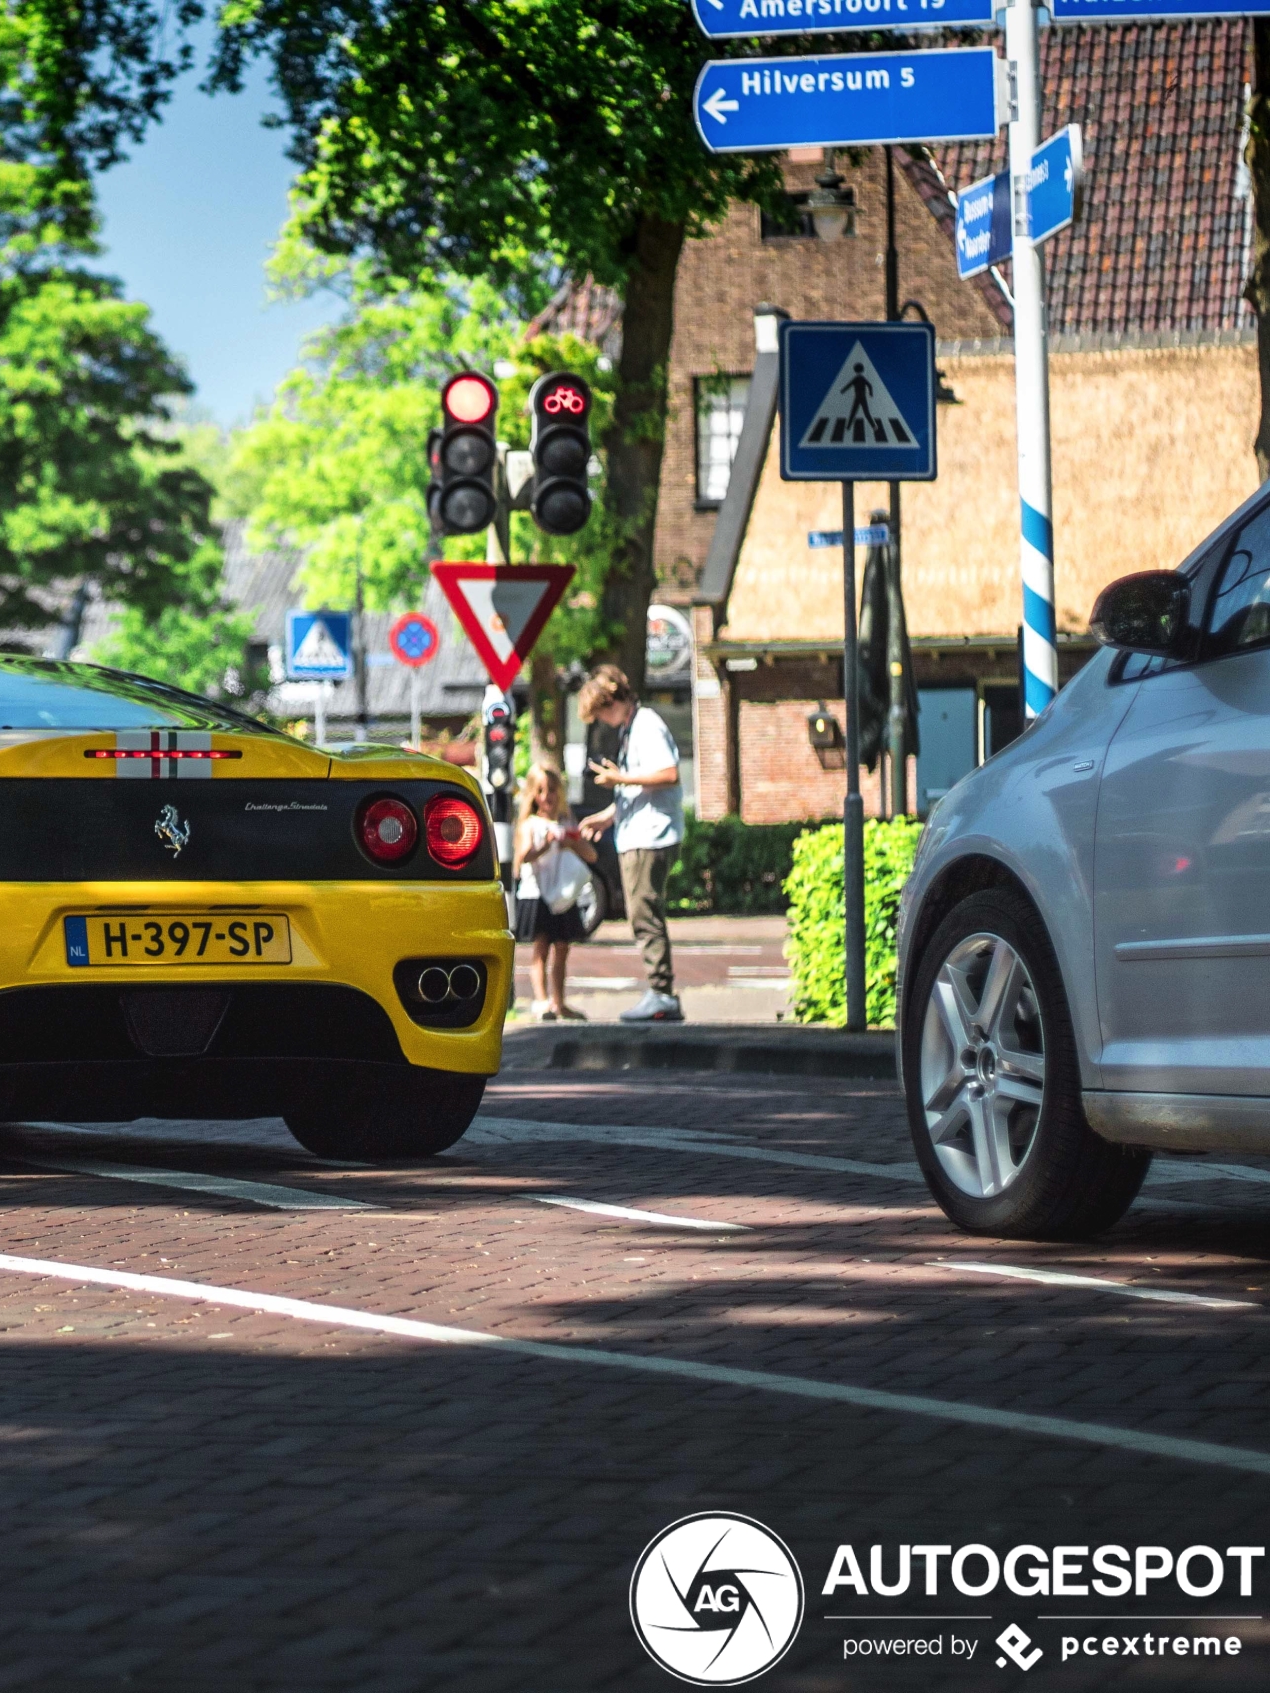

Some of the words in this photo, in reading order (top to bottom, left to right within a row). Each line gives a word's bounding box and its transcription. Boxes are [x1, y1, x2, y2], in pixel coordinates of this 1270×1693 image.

[741, 69, 890, 96] Hilversum
[900, 67, 915, 88] 5
[70, 946, 86, 957] NL
[103, 921, 274, 957] H-397-SP
